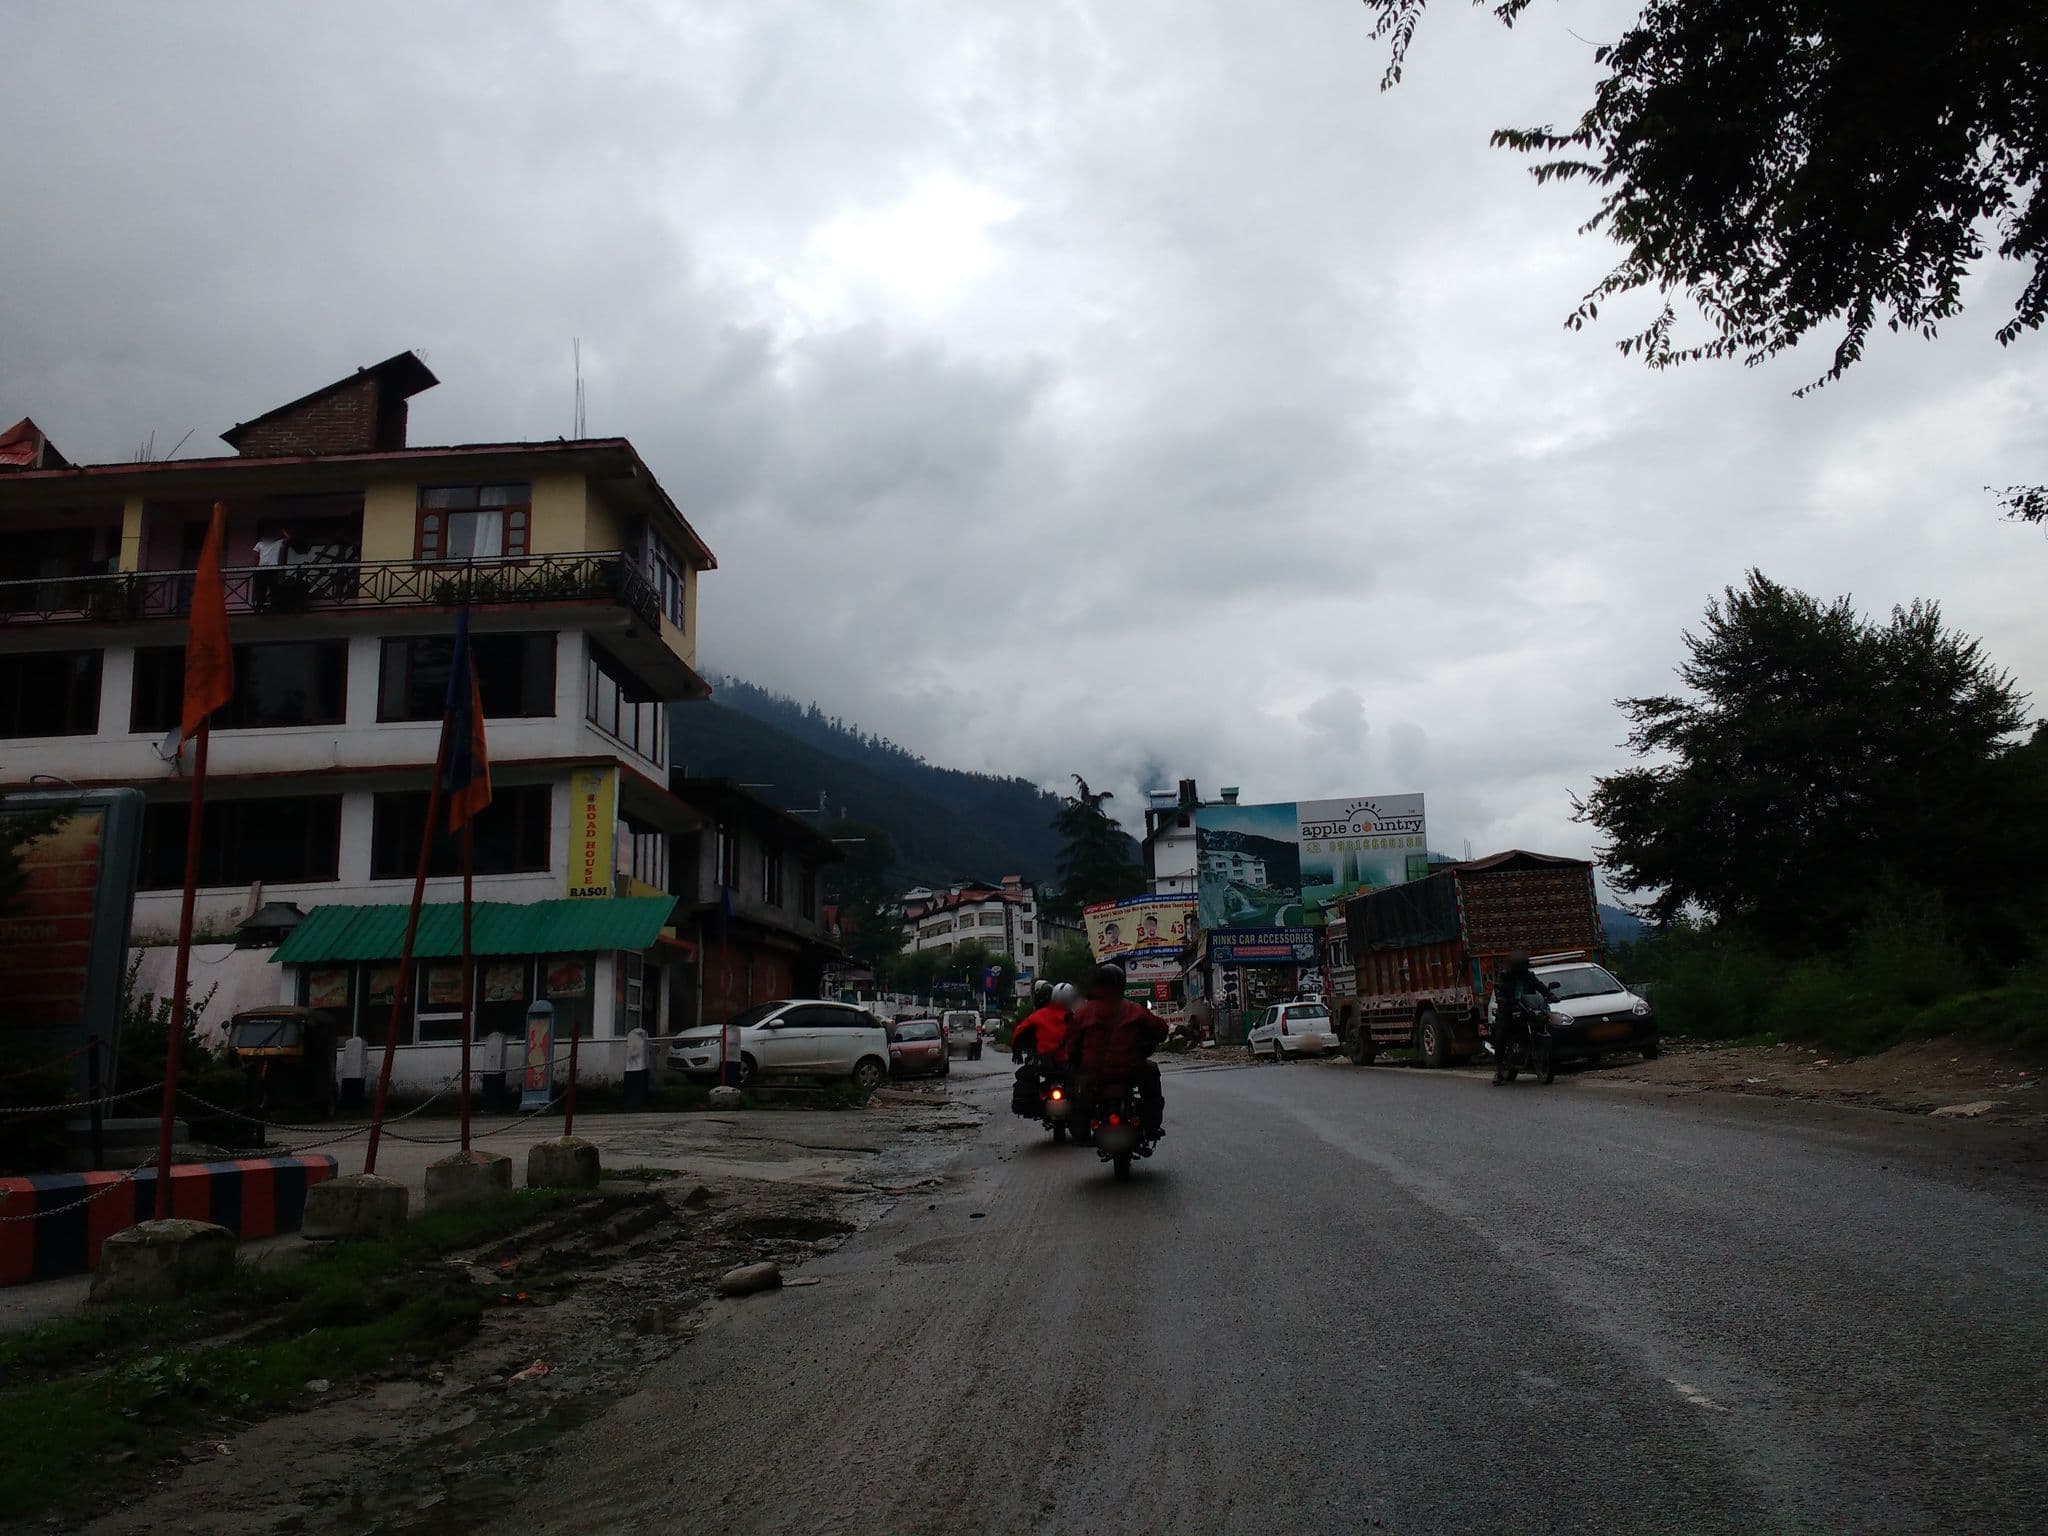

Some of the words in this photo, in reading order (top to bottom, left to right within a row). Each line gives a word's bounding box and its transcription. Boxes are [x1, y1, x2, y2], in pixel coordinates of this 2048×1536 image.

[586, 804, 596, 838] ROAD
[1302, 822, 1347, 838] apple
[1352, 819, 1423, 833] country
[584, 841, 596, 884] HOUSE
[570, 887, 607, 897] RASOI
[1212, 934, 1237, 945] RINKS
[1239, 934, 1256, 945] CAR
[1257, 932, 1314, 944] ACCESSORIES
